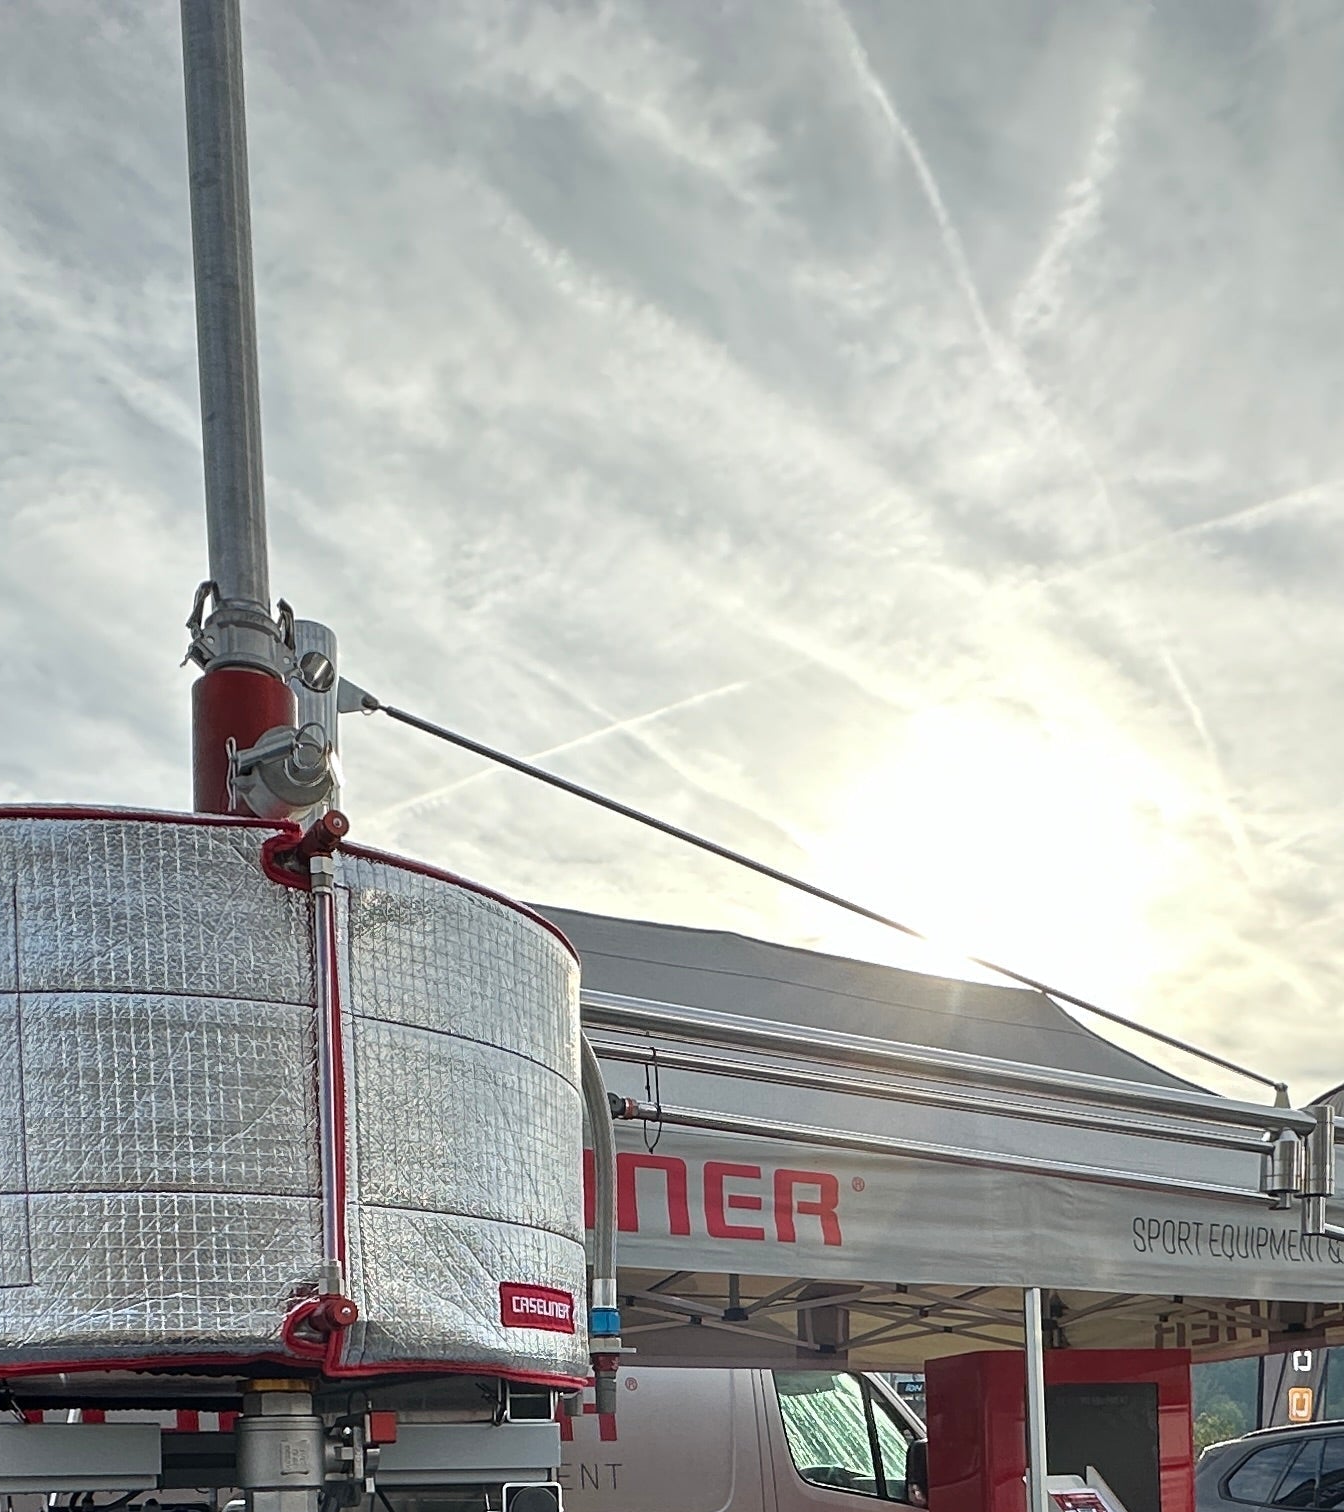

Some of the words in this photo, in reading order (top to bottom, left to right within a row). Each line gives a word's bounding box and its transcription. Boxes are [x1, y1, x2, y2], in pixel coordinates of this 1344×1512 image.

[1133, 1216, 1203, 1256] SPORT
[1209, 1223, 1323, 1263] EQUIPMENT
[511, 1296, 570, 1319] CASELINER
